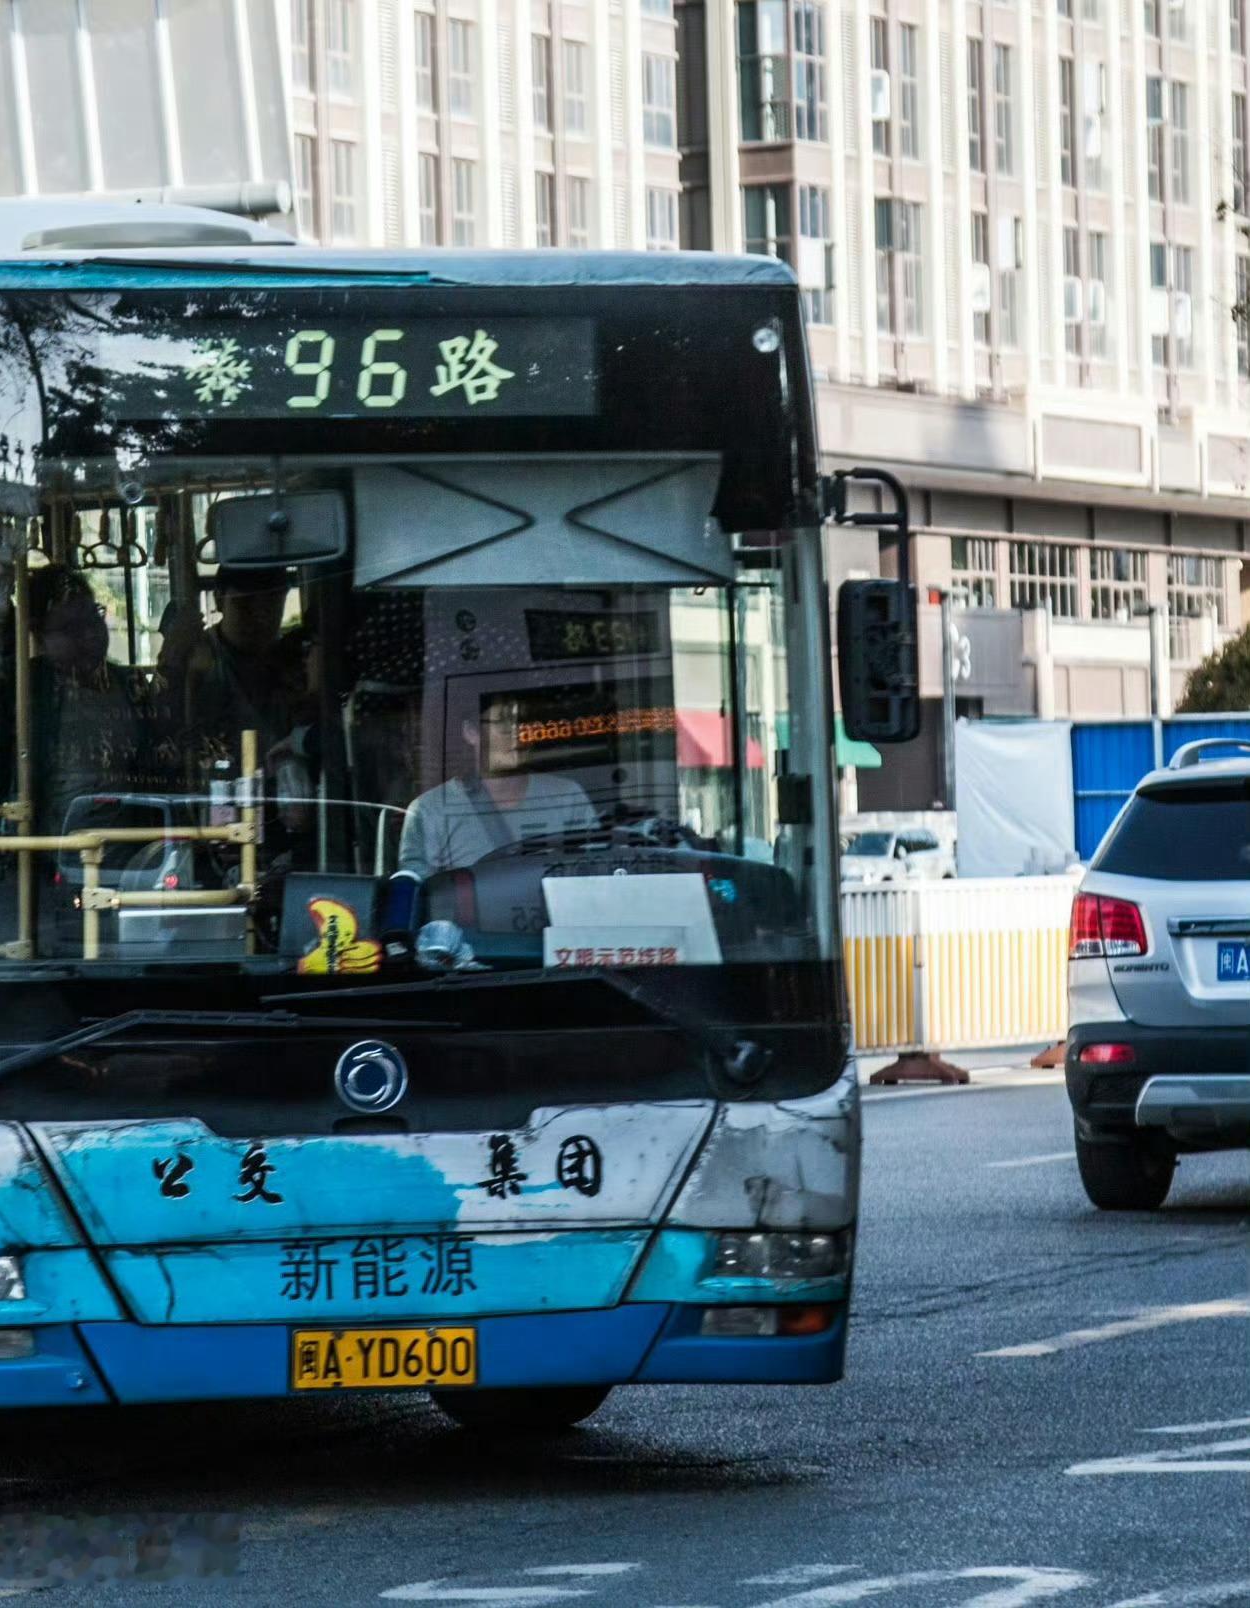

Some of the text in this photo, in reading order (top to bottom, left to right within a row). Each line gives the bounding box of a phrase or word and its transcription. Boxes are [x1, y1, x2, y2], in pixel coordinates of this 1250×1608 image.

[284, 329, 516, 408] 96路
[279, 1235, 478, 1301] 新能源
